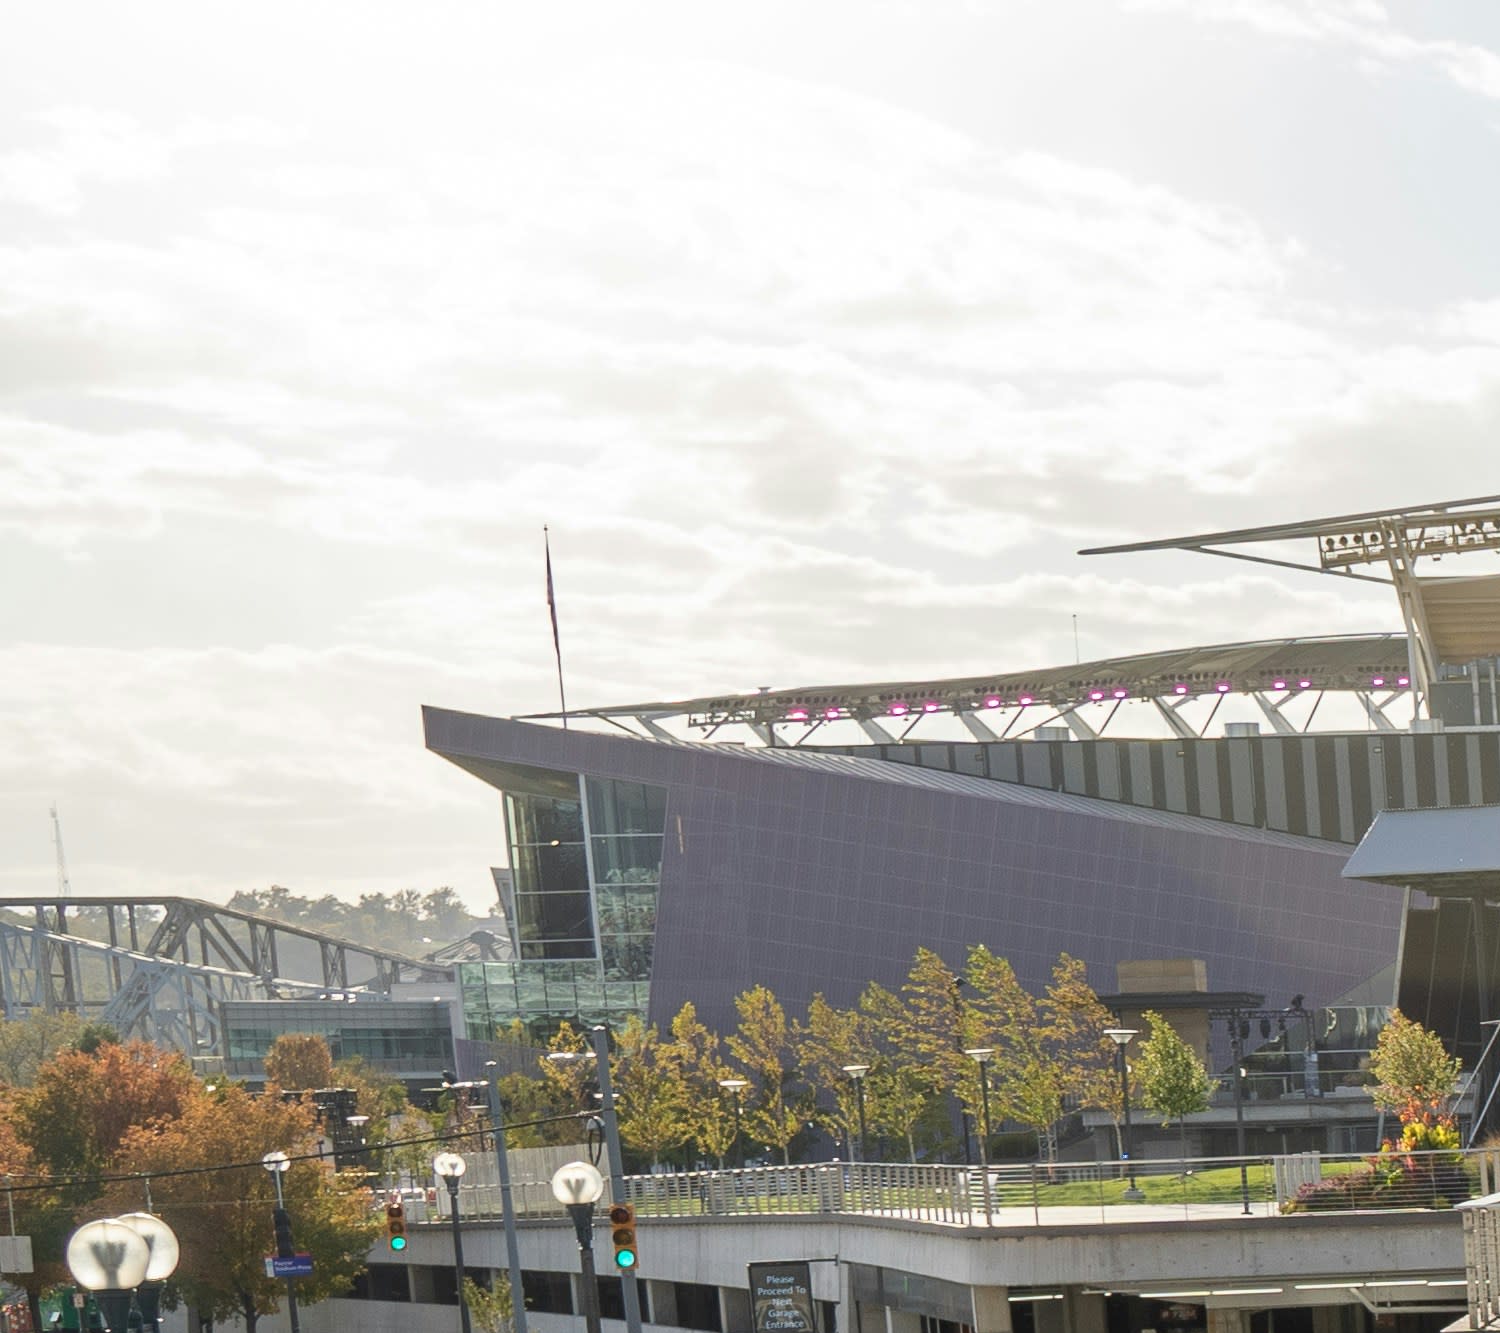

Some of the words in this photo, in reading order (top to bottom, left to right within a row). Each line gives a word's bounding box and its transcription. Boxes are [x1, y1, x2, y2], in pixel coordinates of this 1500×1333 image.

[766, 1275, 795, 1285] Please
[757, 1287, 793, 1296] Proceed
[795, 1285, 806, 1294] To
[772, 1298, 793, 1306] Next
[768, 1309, 799, 1319] Garage
[765, 1320, 804, 1330] Entrance
